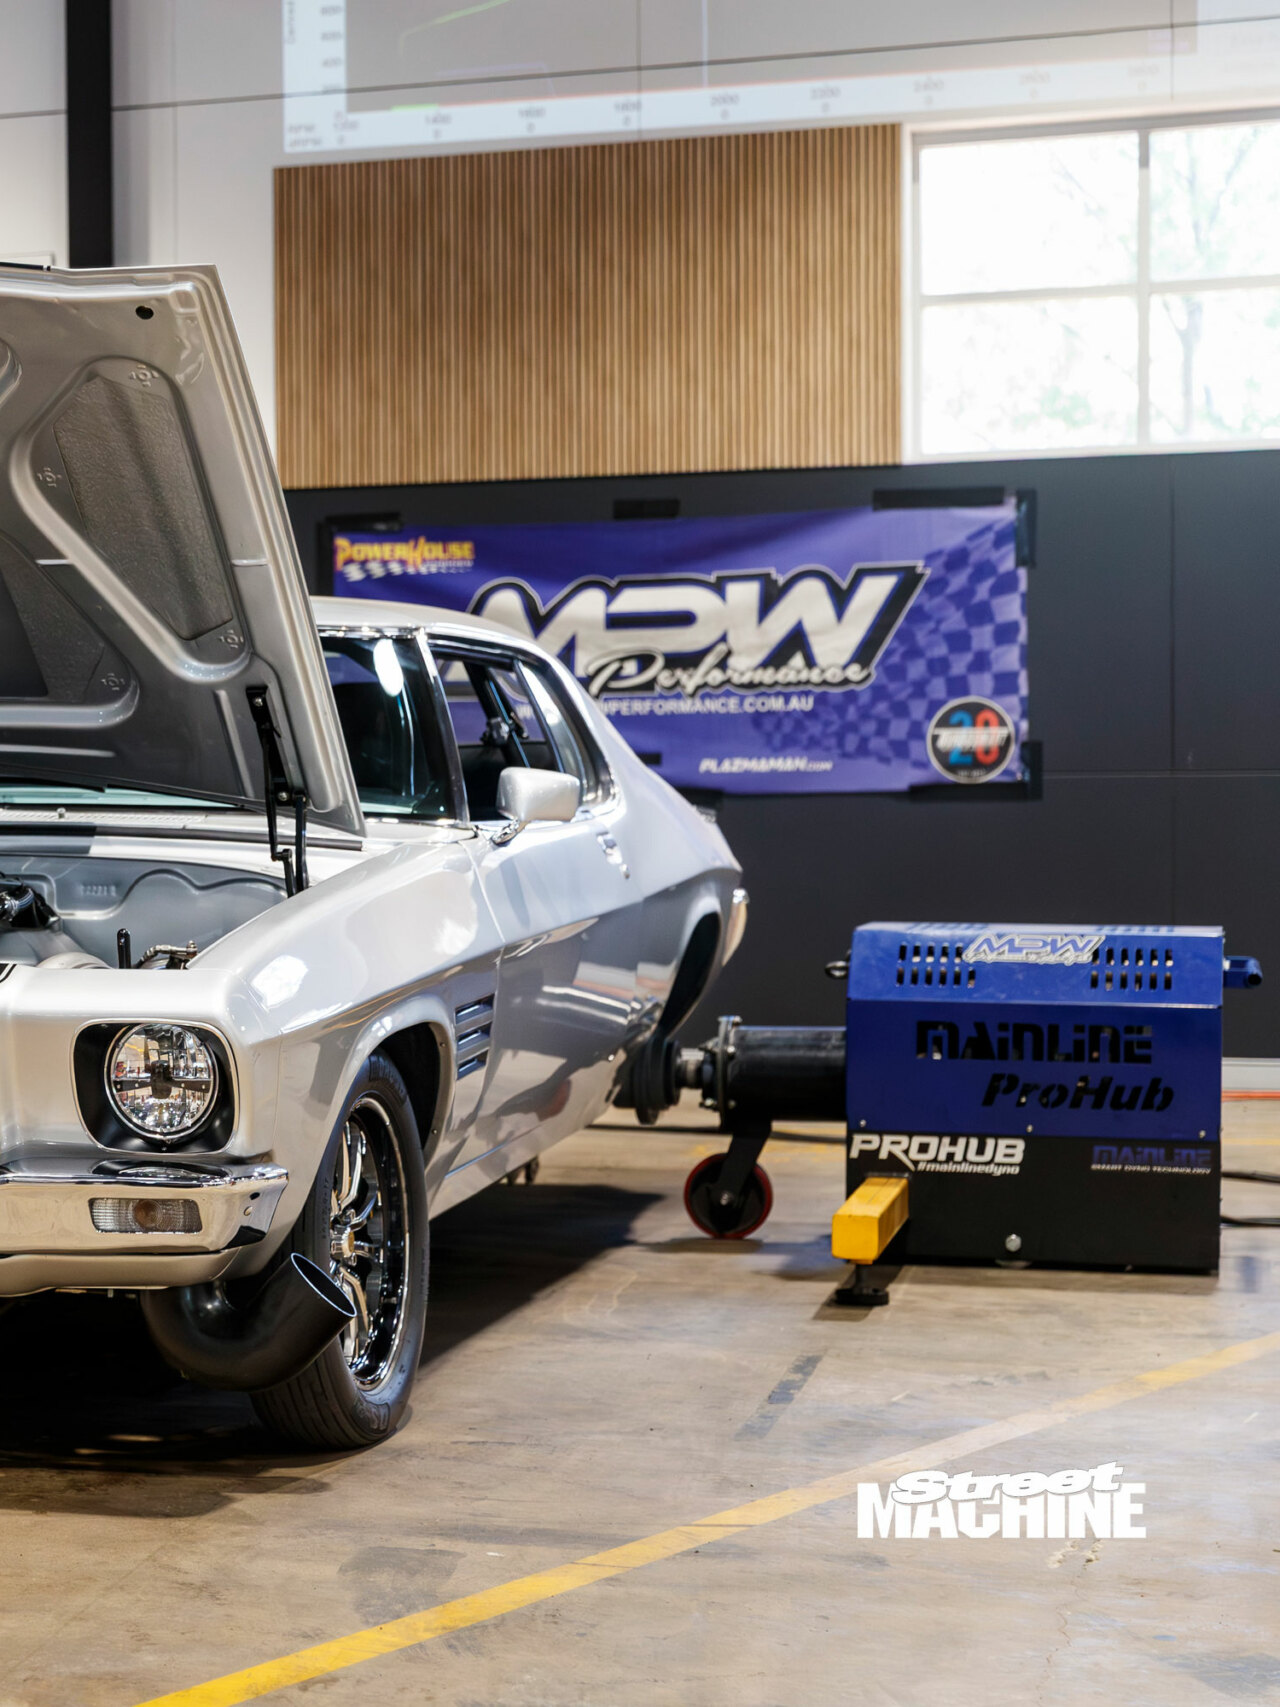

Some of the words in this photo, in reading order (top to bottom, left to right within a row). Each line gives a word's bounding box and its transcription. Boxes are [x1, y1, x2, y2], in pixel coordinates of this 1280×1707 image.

[470, 570, 912, 683] MPW
[587, 641, 873, 696] Performance
[970, 934, 1104, 955] MPW
[981, 1073, 1174, 1112] ProHub
[849, 1133, 1026, 1172] PROHUB
[917, 1161, 1020, 1177] #mainlinedyno
